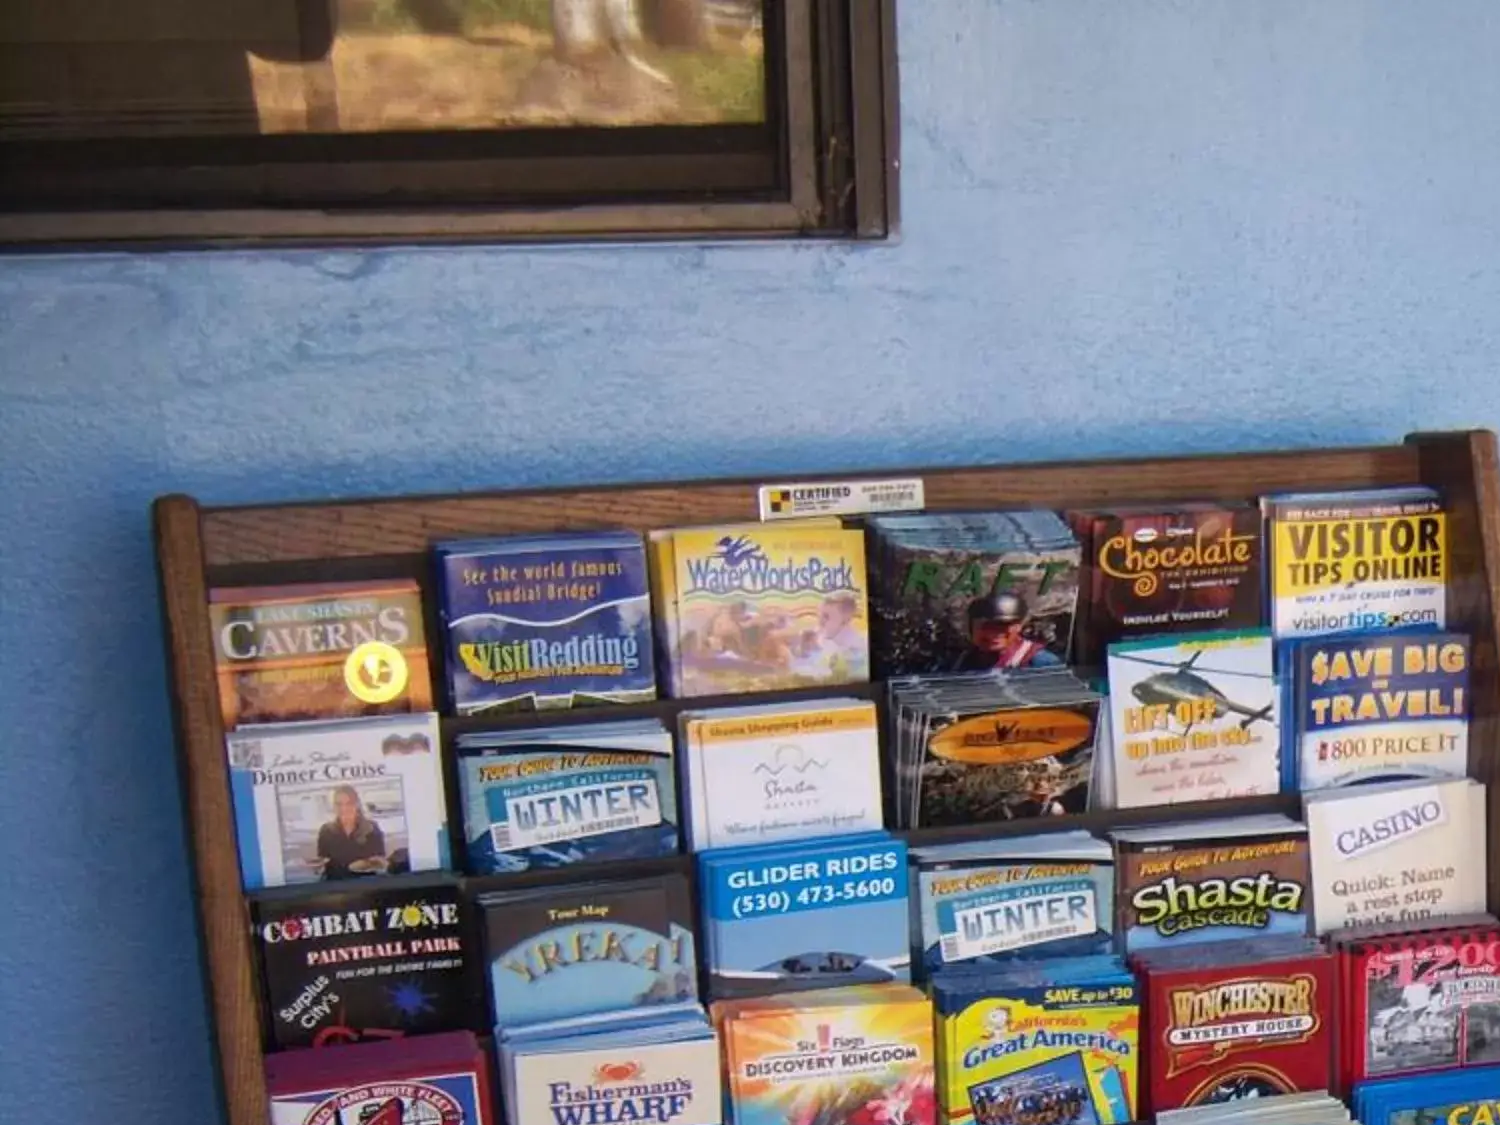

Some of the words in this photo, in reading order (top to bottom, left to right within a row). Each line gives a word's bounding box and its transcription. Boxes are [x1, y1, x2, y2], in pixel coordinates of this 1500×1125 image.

[793, 486, 851, 501] CERTIFIED
[1288, 518, 1439, 560] VISITOR
[463, 567, 488, 586] See
[493, 565, 517, 582] the
[524, 562, 564, 579] world
[571, 560, 622, 577] famous
[686, 555, 855, 592] WaterWorksPark
[904, 559, 1069, 598] RAFT
[1100, 528, 1255, 597] Chocolate
[1288, 562, 1342, 586] TIPS
[1354, 555, 1440, 581] ONLINE
[487, 584, 541, 606] Sundial
[221, 607, 409, 659] CAVERNS
[1404, 643, 1465, 675] BIG
[1312, 688, 1463, 725] TRAVEL!
[1331, 739, 1366, 760] 800
[1372, 735, 1432, 755] PRICE
[1439, 733, 1459, 751] IT
[253, 768, 320, 785] Dinner
[323, 763, 386, 779] Cruise
[513, 784, 651, 830] WINTER
[1336, 800, 1441, 855] CASINO
[727, 861, 821, 890] GLIDER
[826, 852, 899, 881] RIDES
[1331, 875, 1396, 897] Quick:
[1401, 865, 1455, 886] Name
[548, 908, 579, 921] Tour
[581, 904, 609, 917] Map
[731, 888, 791, 920] (530)
[797, 876, 896, 906] 473-5600
[1347, 901, 1358, 914] a
[1364, 893, 1400, 911] rest
[1403, 888, 1443, 906] stop
[263, 909, 378, 943] COMBAT
[386, 903, 459, 930] ZONE
[962, 895, 1088, 941] WINTER
[306, 941, 407, 966] PAINTBALL
[410, 937, 462, 954] PARK
[502, 929, 661, 984] YREKA
[335, 970, 355, 980] FUN
[356, 966, 375, 977] FOR
[378, 964, 393, 975] THE
[395, 961, 425, 973] ENTIRE
[279, 974, 330, 1023] Surplus
[301, 992, 340, 1029] City's
[1044, 988, 1081, 1003] SAVE
[1109, 987, 1132, 999] $30
[1173, 979, 1311, 1027] WINCHESTER
[797, 1040, 816, 1052] Six
[833, 1037, 865, 1049] Flags
[1180, 1024, 1249, 1039] MYSTERY
[1256, 1018, 1303, 1032] HOUSE
[745, 1057, 836, 1077] DISCOVERY
[842, 1047, 917, 1066] KINGDOM
[963, 1033, 1029, 1068] Great
[1032, 1029, 1130, 1055] America
[339, 1088, 369, 1107] AND
[372, 1086, 415, 1098] WHITE
[418, 1090, 454, 1115] FLEET
[548, 1076, 693, 1104] Fisherman's
